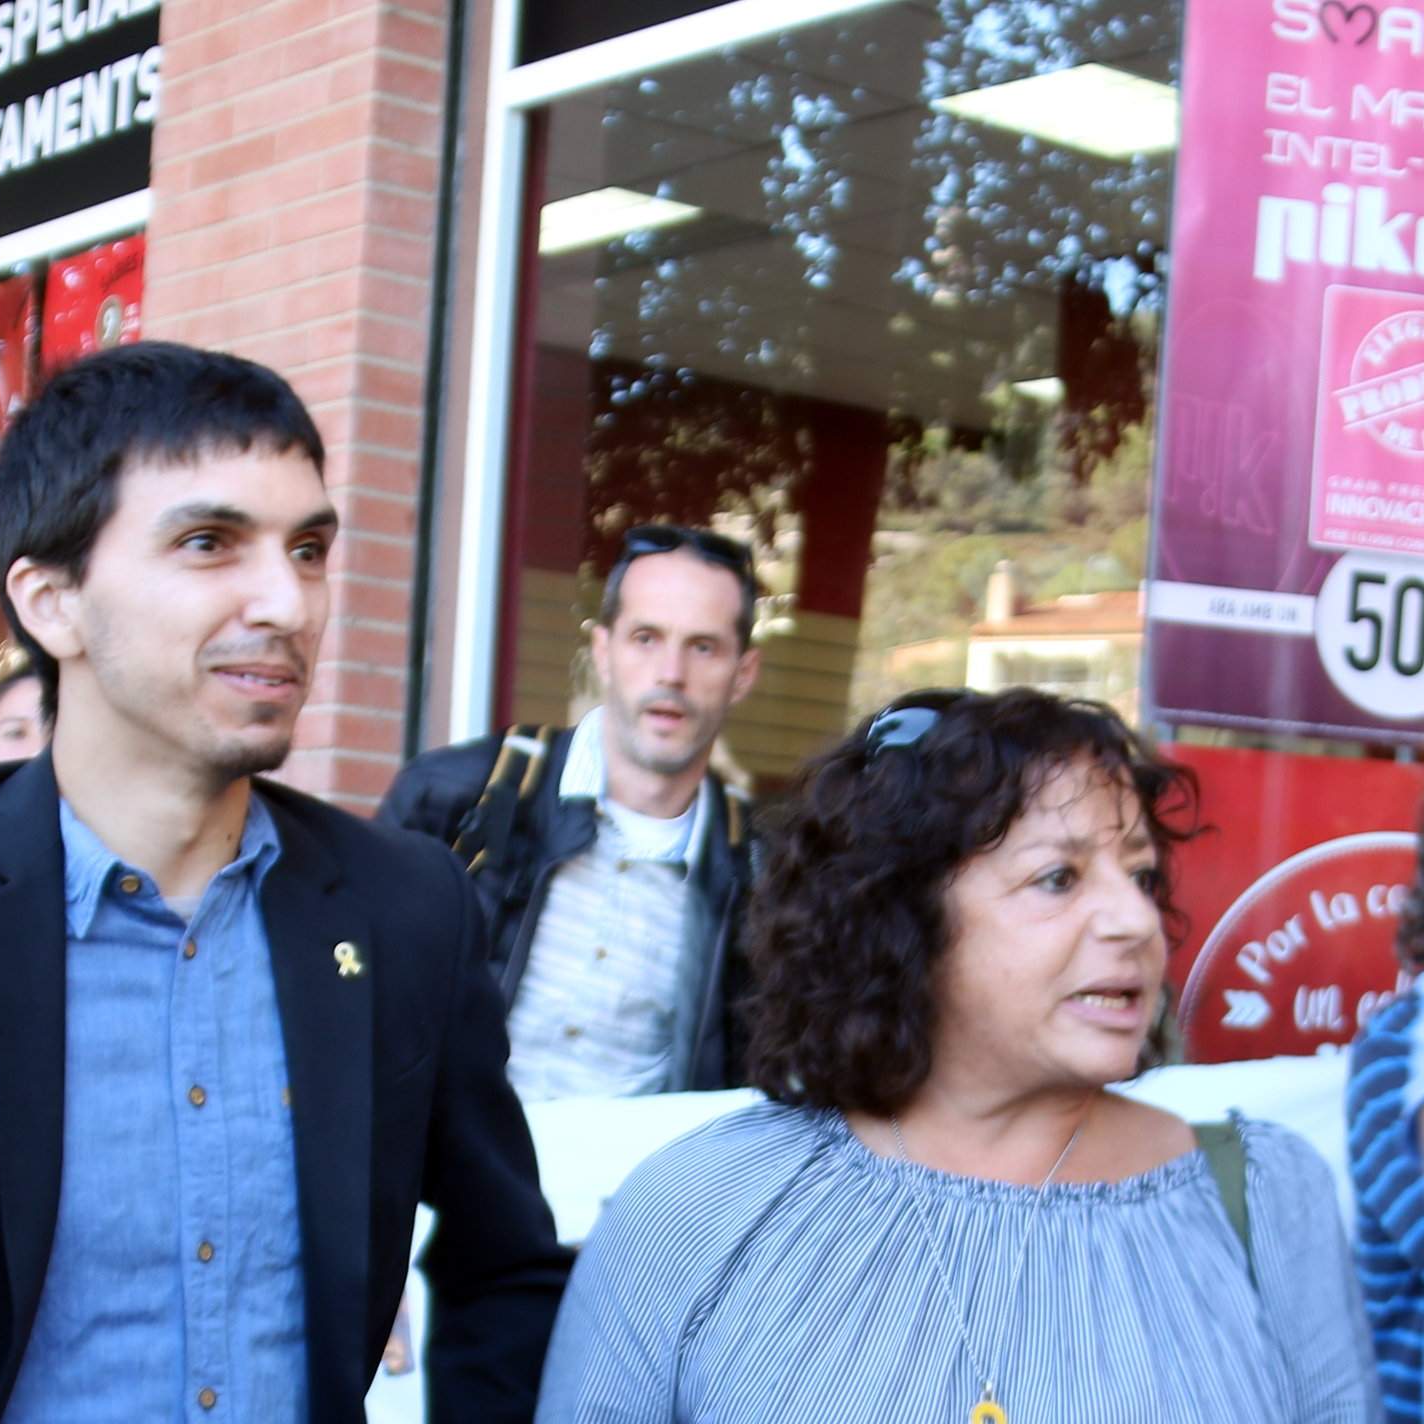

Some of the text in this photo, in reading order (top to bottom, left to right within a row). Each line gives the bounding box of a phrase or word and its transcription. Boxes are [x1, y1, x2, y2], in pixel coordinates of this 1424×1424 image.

[1265, 72, 1334, 119] EL
[1236, 913, 1308, 986] Por
[1310, 890, 1361, 931] la
[1293, 984, 1346, 1032] un
